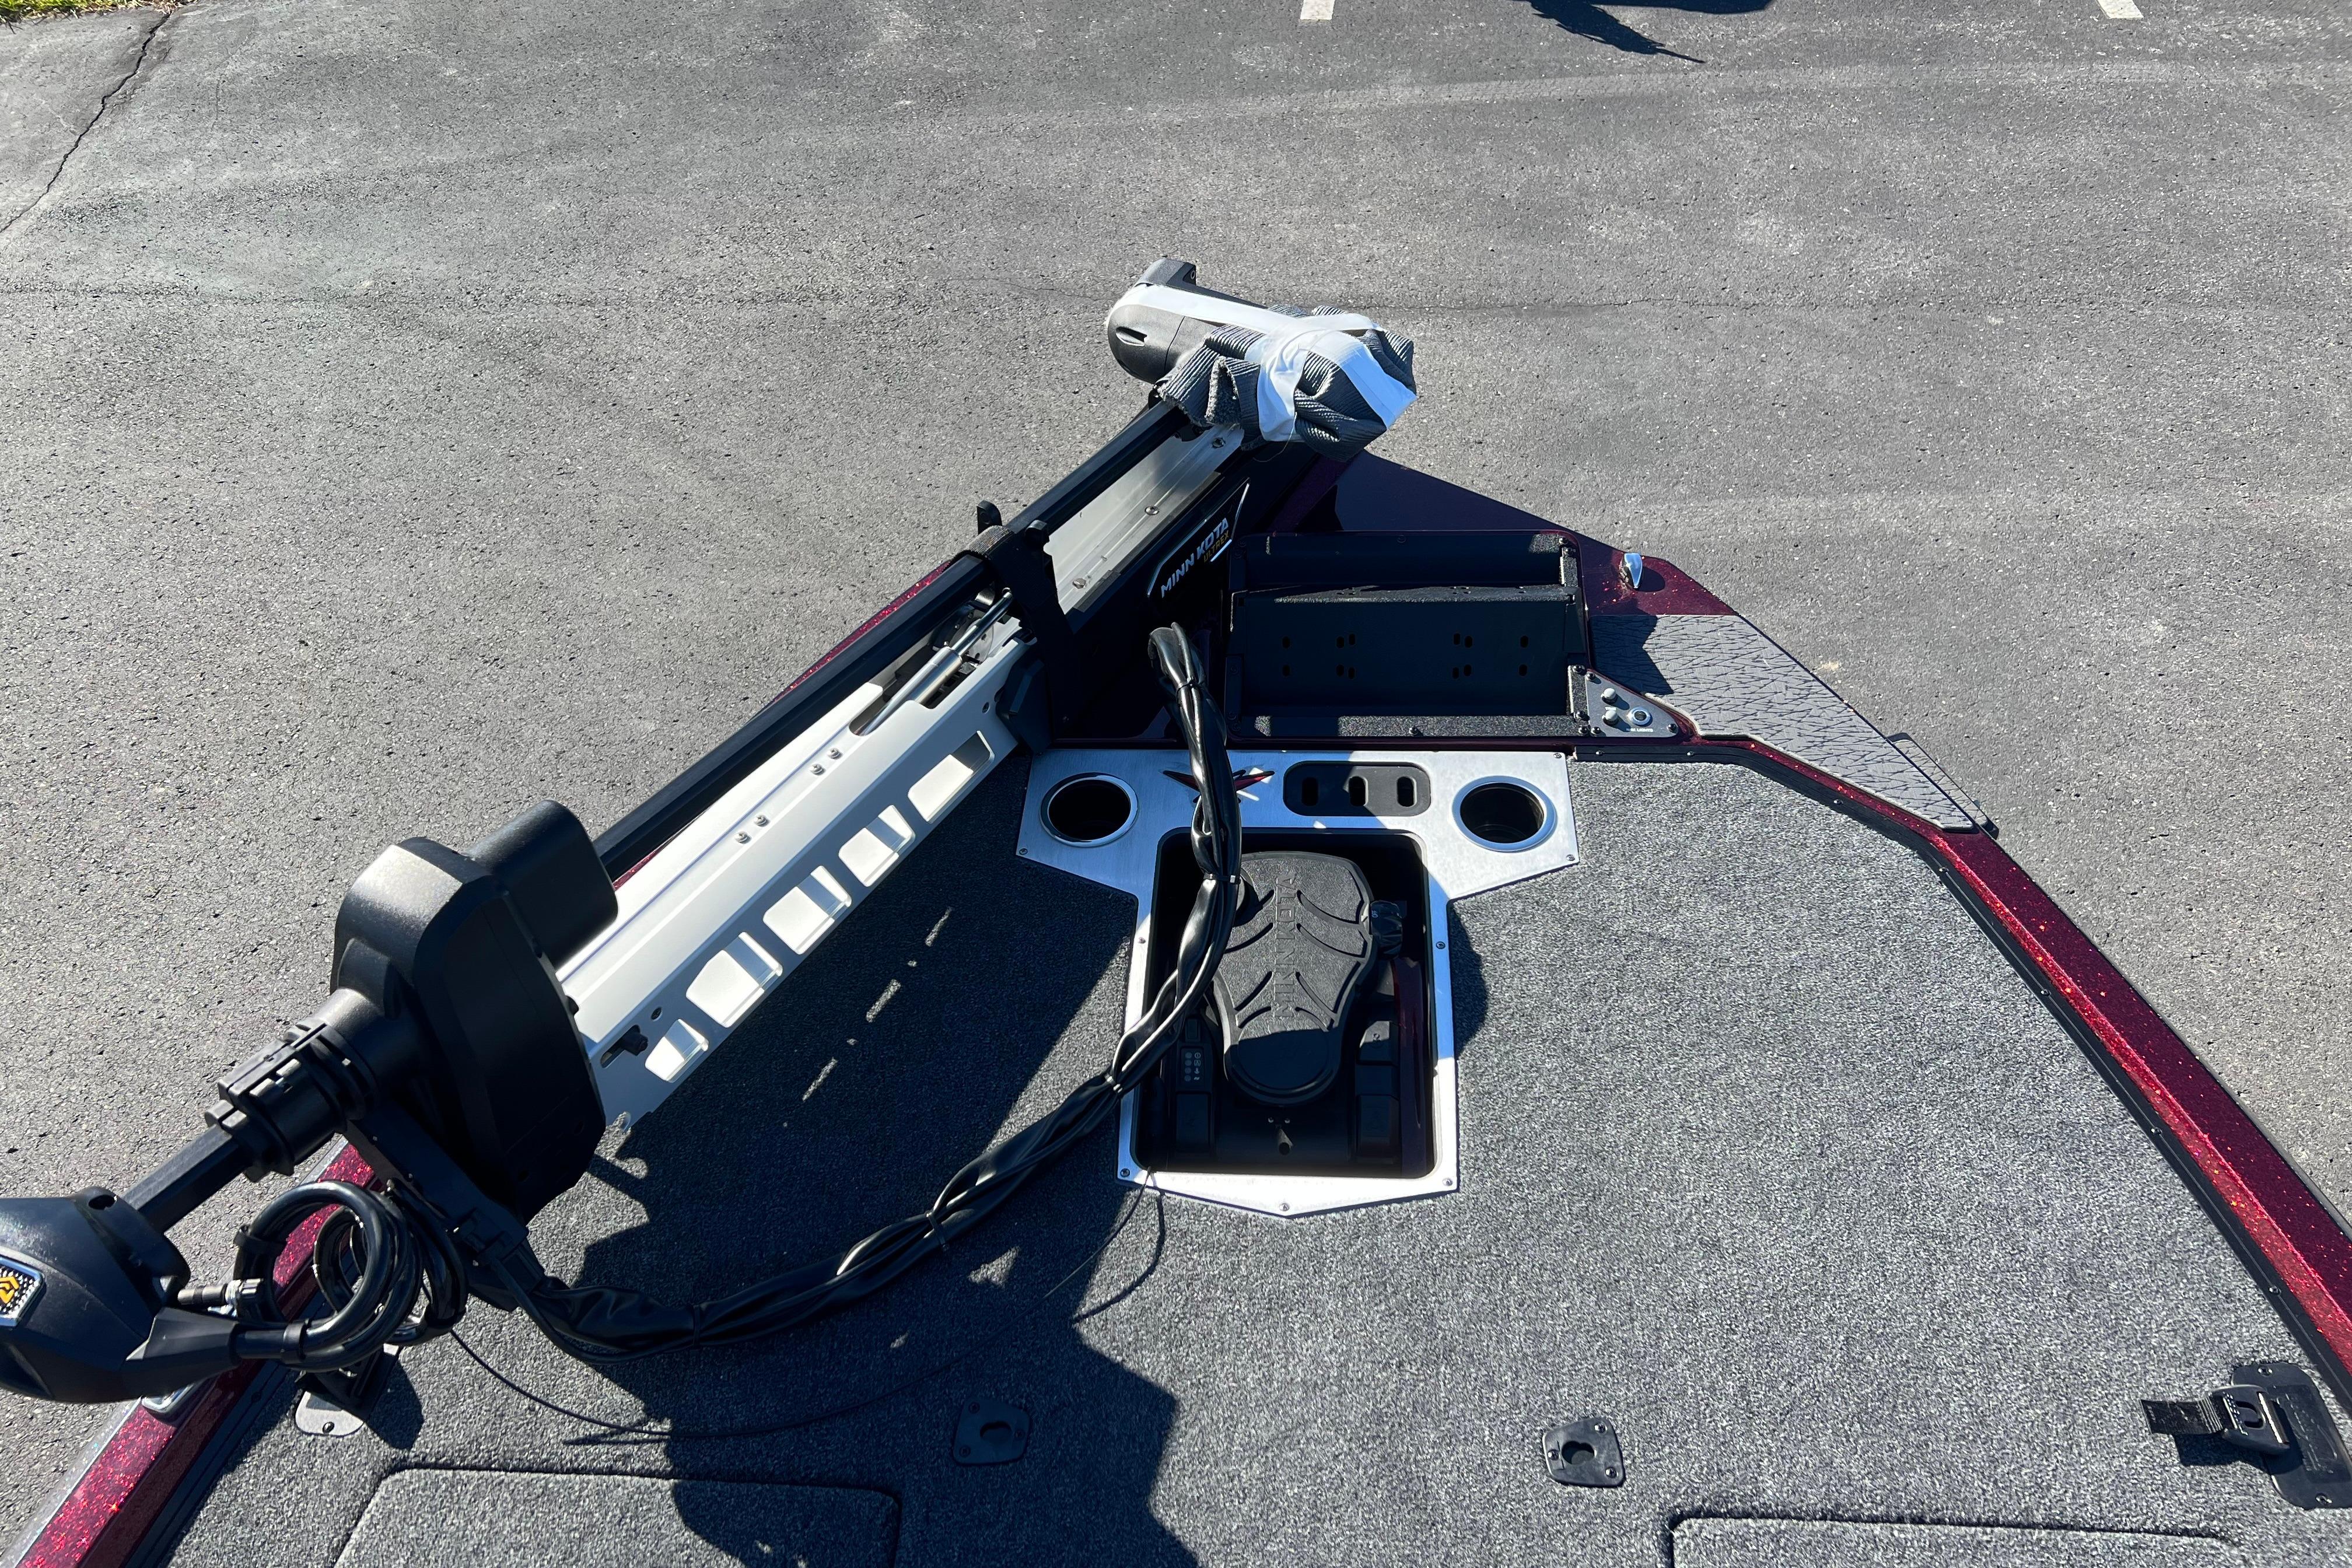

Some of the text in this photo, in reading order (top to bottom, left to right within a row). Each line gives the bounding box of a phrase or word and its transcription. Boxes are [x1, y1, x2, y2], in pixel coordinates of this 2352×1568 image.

[1160, 517, 1229, 598] MINN KOTA
[1203, 530, 1230, 564] ULTREX
[1273, 873, 1297, 1017] MINN KOTA
